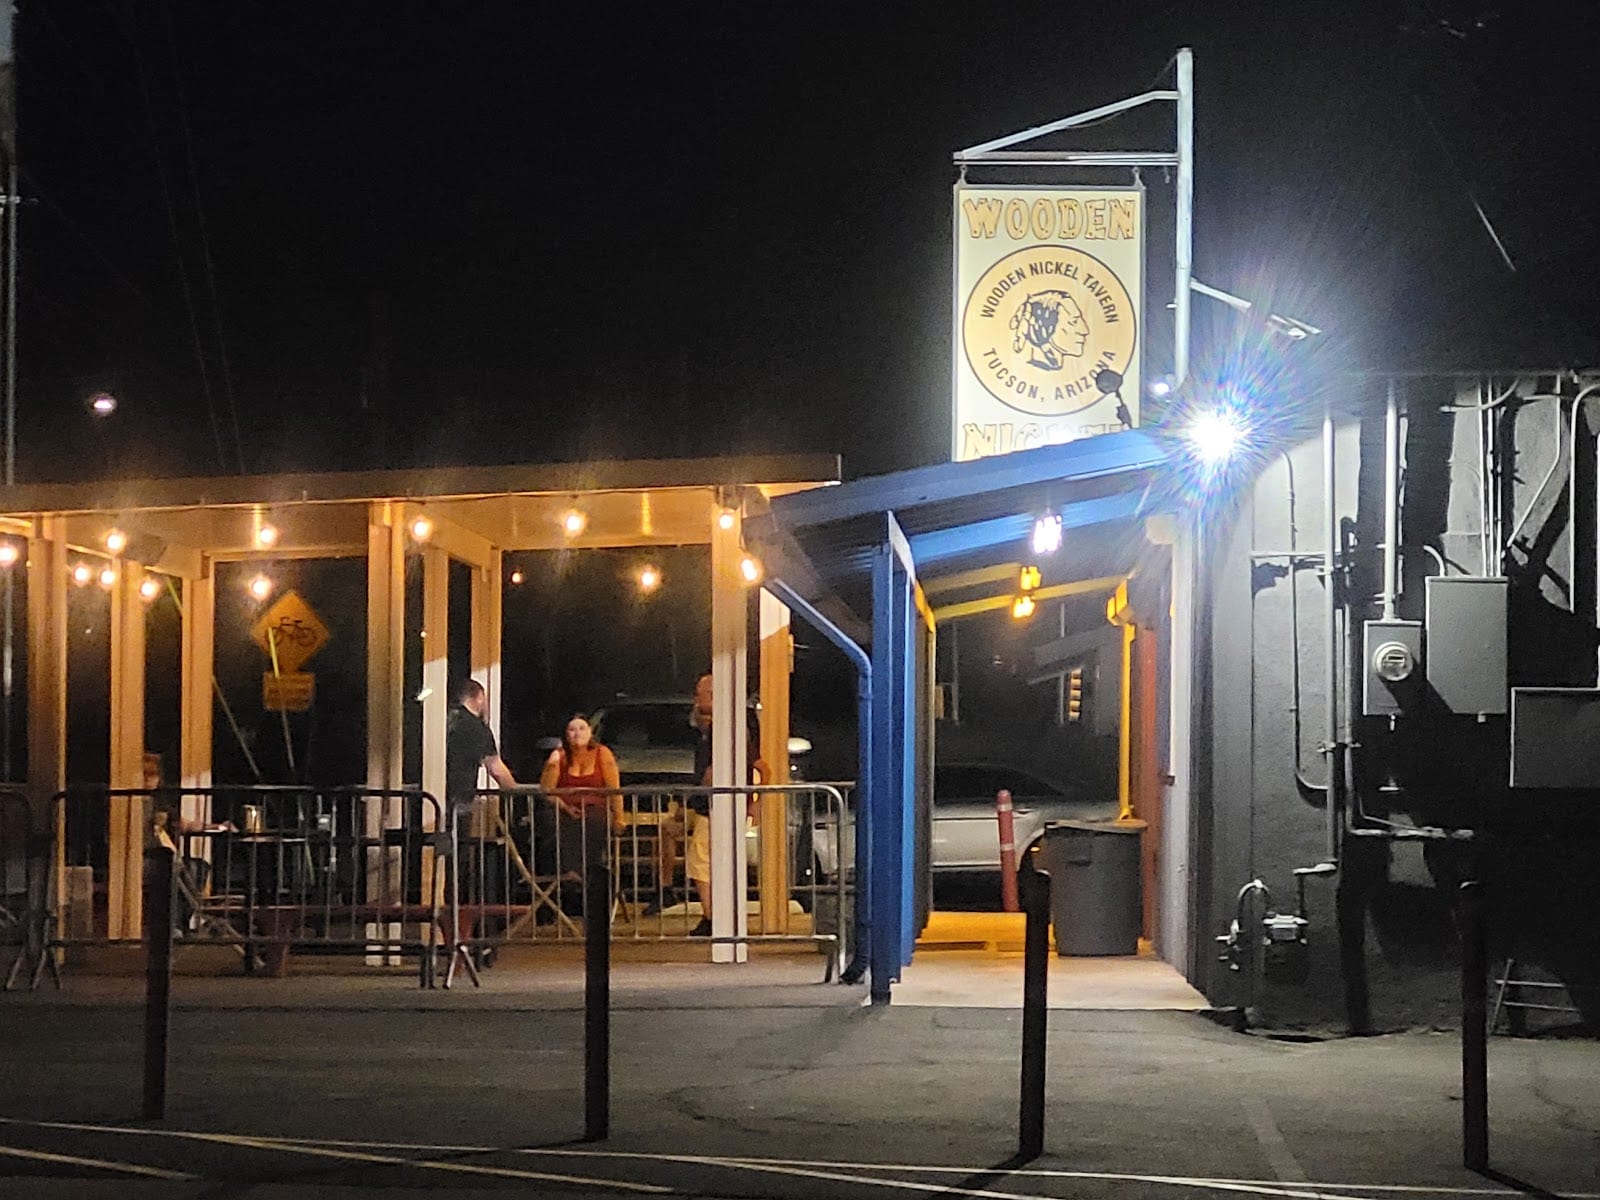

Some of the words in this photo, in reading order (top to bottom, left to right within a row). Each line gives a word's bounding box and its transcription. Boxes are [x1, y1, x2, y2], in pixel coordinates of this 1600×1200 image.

[964, 199, 1135, 239] WOODEN
[980, 267, 1026, 317] WOODEN
[1030, 261, 1078, 280] NICKEL
[1083, 273, 1118, 323] TAVERN
[982, 348, 1044, 401] TUCSON,
